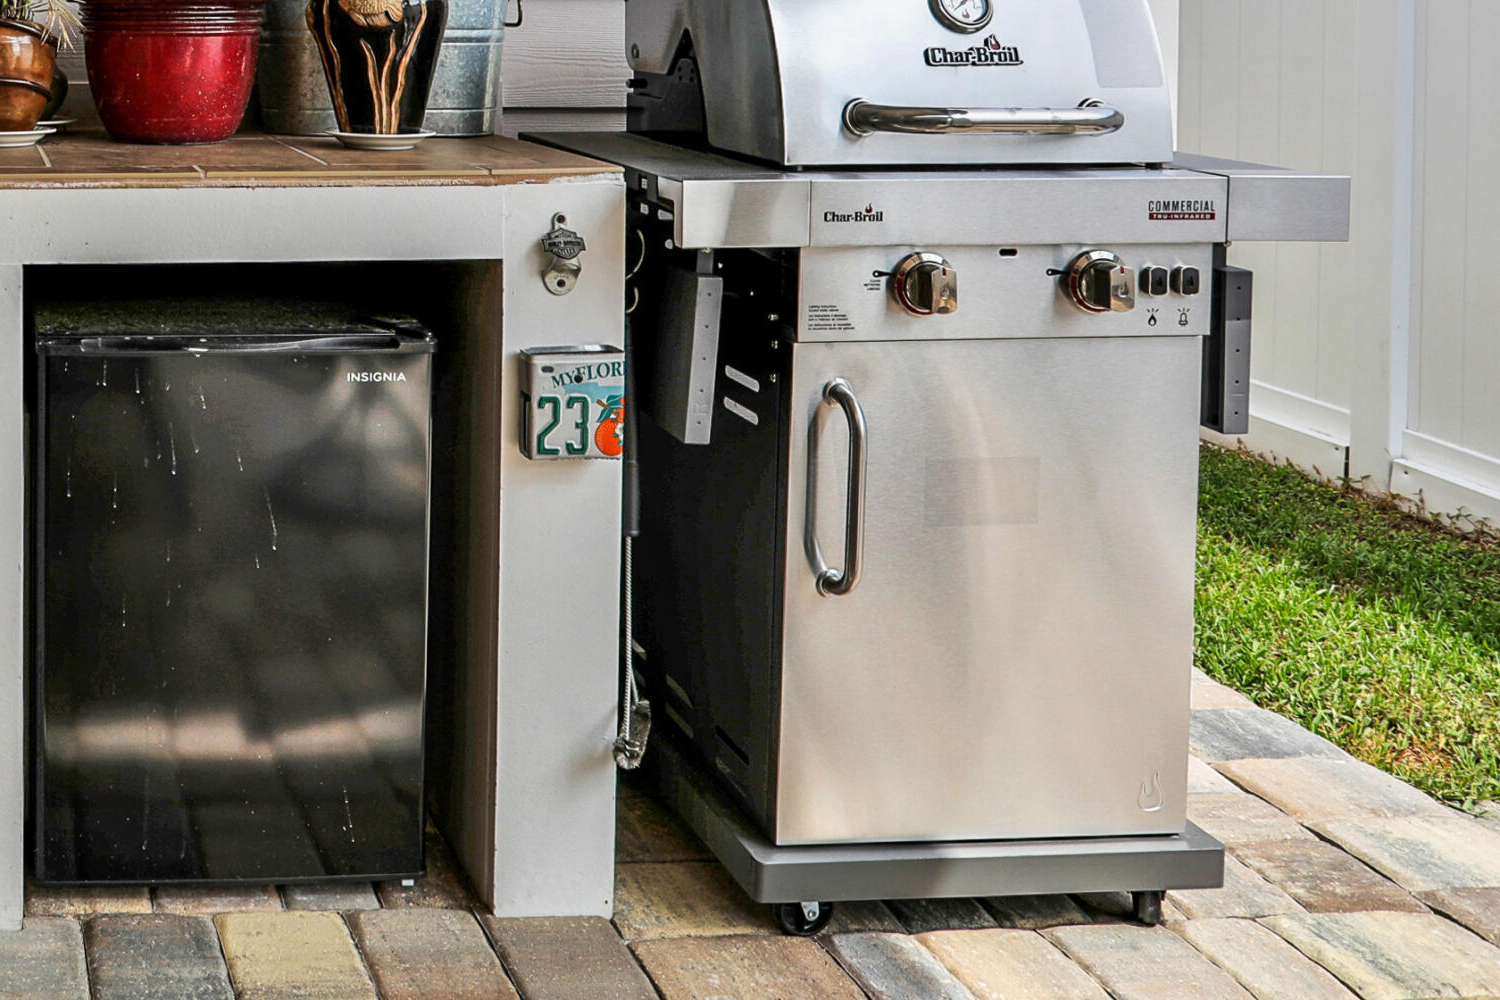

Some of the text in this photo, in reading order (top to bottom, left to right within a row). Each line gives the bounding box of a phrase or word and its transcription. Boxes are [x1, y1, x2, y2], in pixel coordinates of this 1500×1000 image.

[928, 46, 1020, 64] Char-Broil
[1148, 200, 1215, 212] COMMERCIAL
[823, 210, 883, 222] Char-Broil
[347, 372, 407, 382] INSIGNIA
[537, 395, 589, 456] 23
